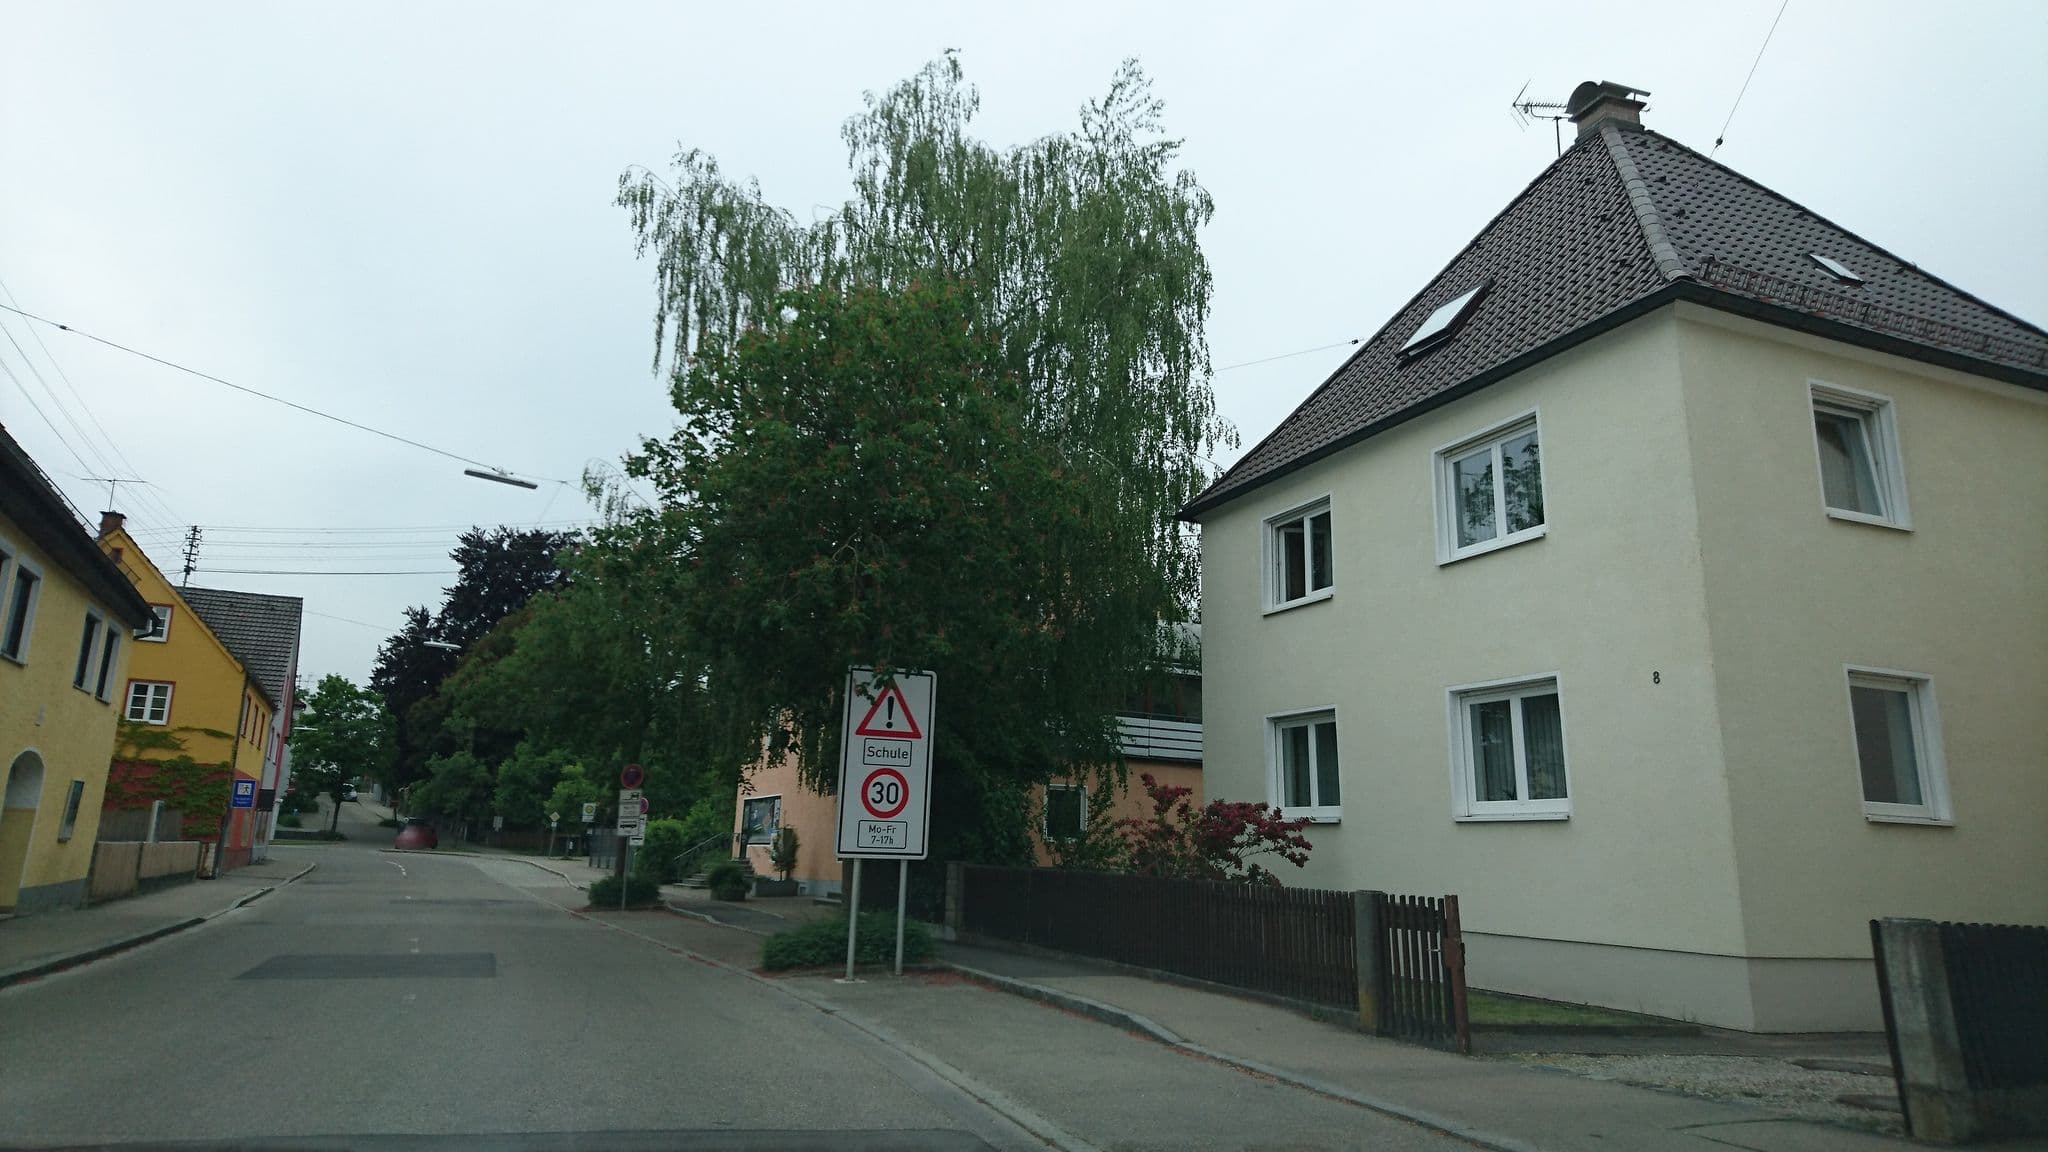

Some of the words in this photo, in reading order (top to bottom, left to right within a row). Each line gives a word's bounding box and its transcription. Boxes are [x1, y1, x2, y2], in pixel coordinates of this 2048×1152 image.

[1653, 671, 1661, 684] 8
[867, 746, 908, 760] Schule
[871, 781, 899, 804] 30
[868, 825, 897, 834] Mo-Fr
[871, 836, 894, 845] 7-17h
